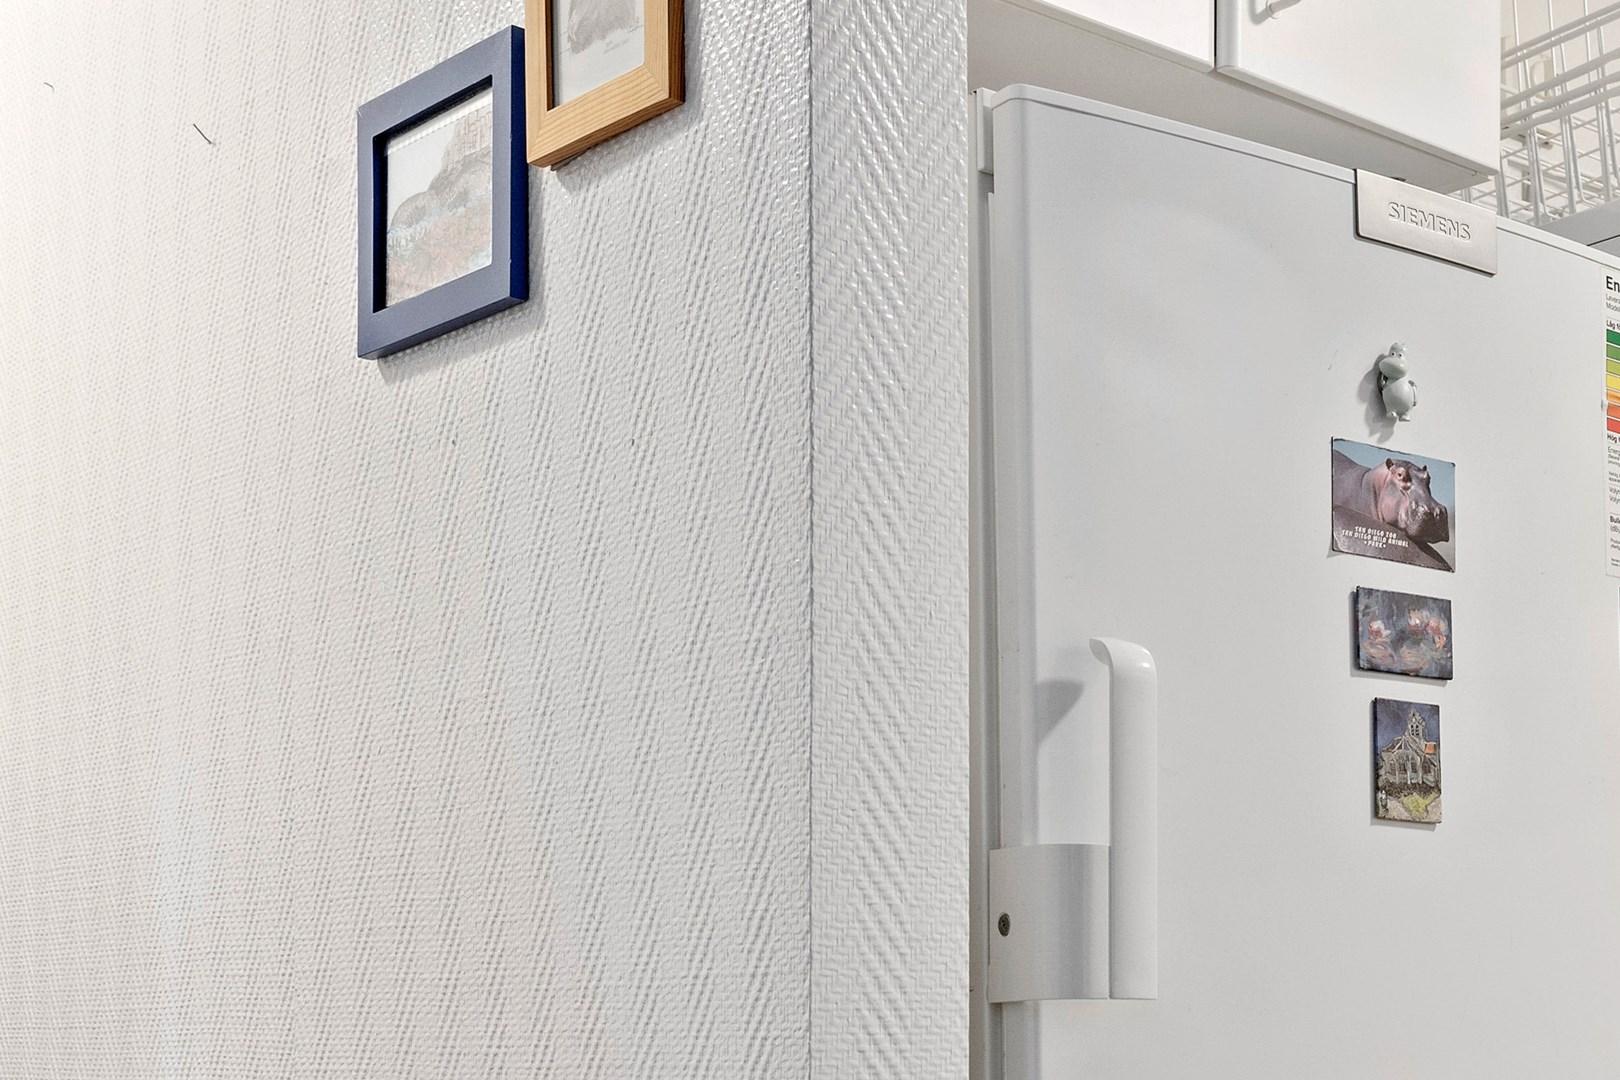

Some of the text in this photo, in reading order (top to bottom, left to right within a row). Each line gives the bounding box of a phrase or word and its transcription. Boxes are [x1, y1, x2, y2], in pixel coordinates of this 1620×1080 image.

[1388, 201, 1471, 242] SIEMENS
[1606, 320, 1615, 330] Låg
[1607, 433, 1617, 444] Hög
[1342, 529, 1409, 548] SAN DIEGO WILD ANIMAL
[1355, 526, 1397, 539] SAN DIEGO ZOO
